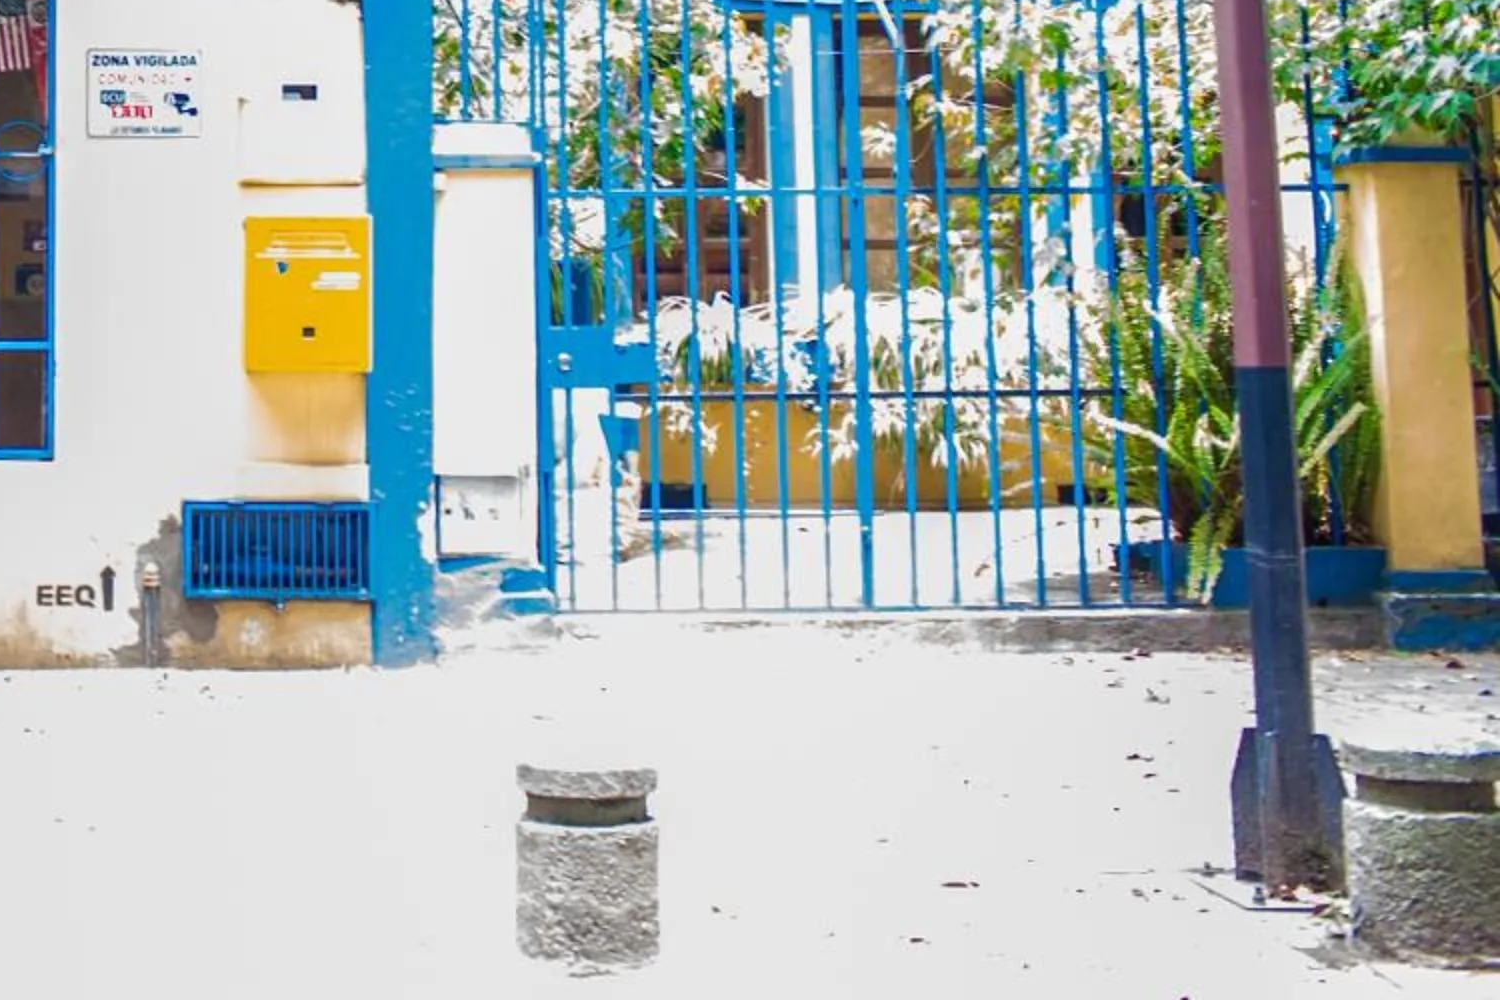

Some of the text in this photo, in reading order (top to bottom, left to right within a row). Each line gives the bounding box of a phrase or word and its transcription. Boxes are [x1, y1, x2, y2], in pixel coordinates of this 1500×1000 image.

[92, 55, 197, 67] ZONA VIGILADA
[36, 585, 96, 608] EEQ
